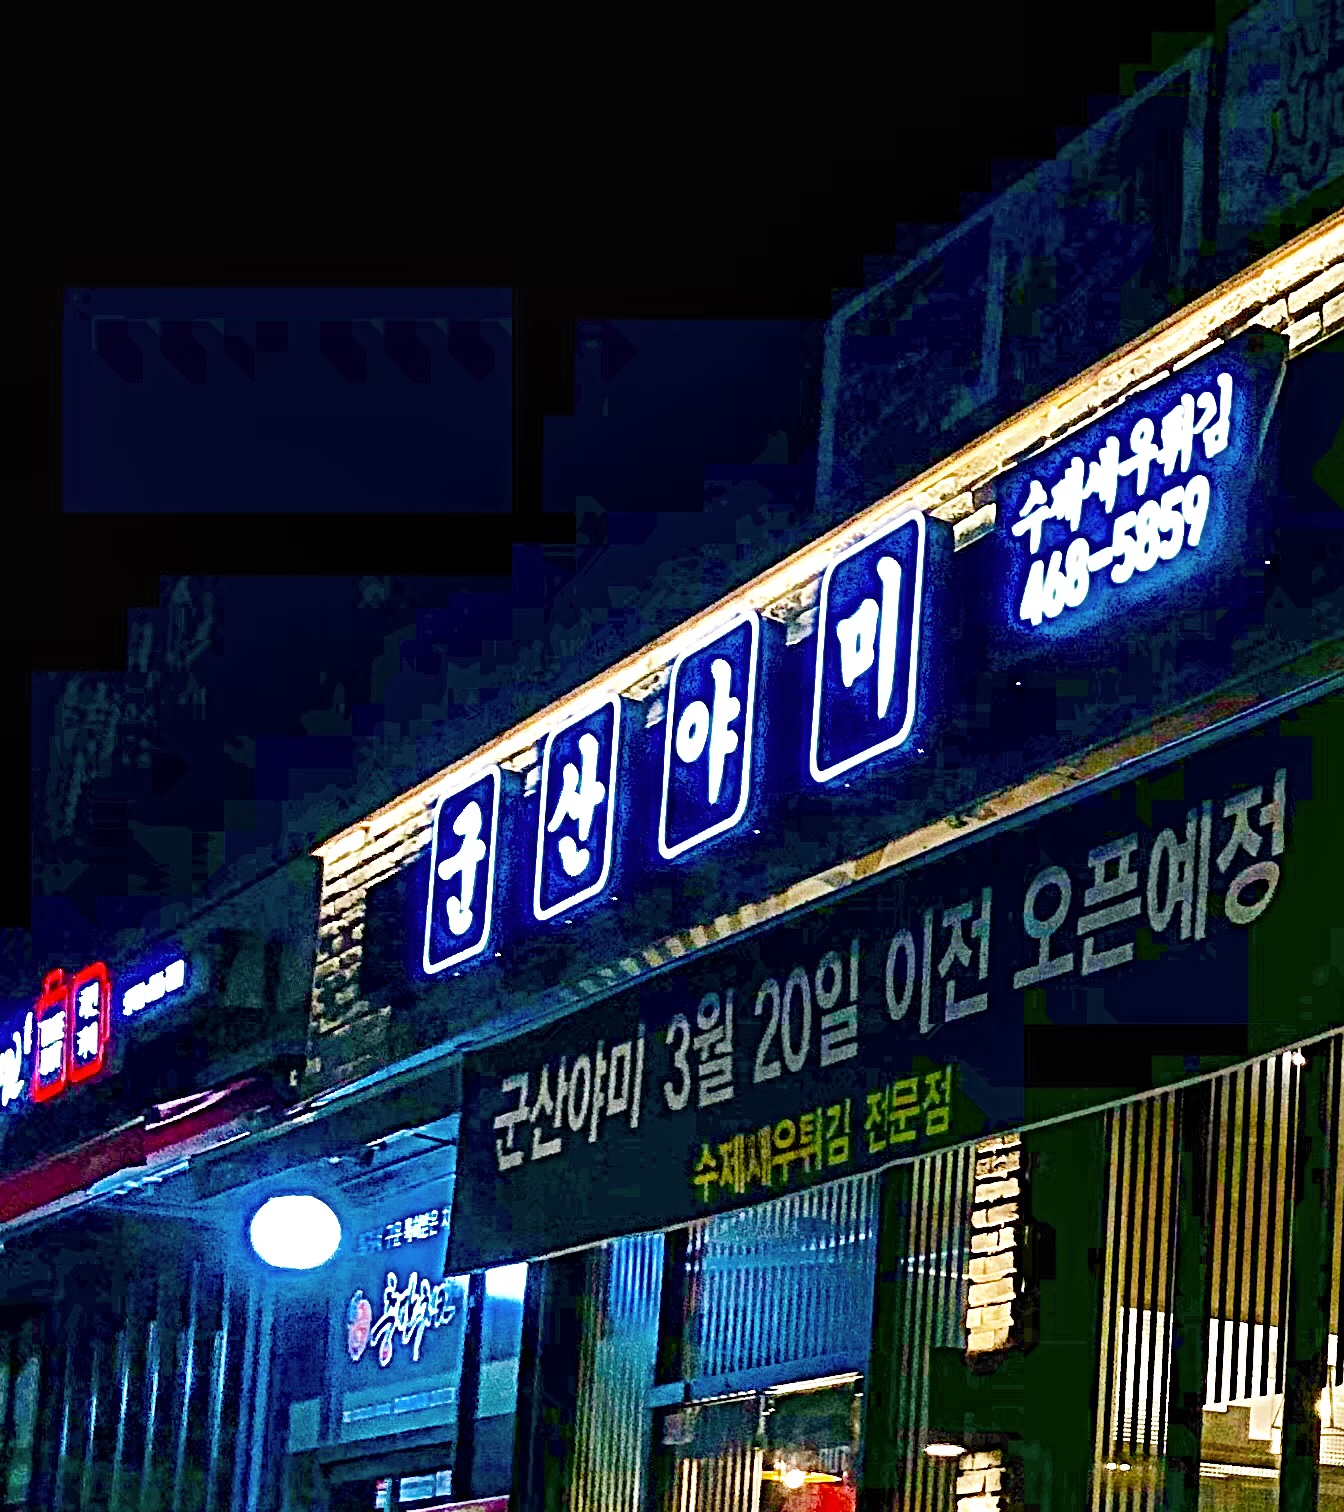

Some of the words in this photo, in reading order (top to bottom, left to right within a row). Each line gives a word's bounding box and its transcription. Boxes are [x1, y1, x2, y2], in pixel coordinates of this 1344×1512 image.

[1019, 474, 1211, 626] 468-5859
[438, 556, 902, 938] 군산야미
[493, 1023, 645, 1171] 군산야미
[664, 988, 736, 1110] 3월
[752, 933, 860, 1083] 20일
[885, 886, 992, 1034] 이전
[693, 1097, 852, 1204] 수제새우튀김
[863, 1063, 956, 1154] 전문점
